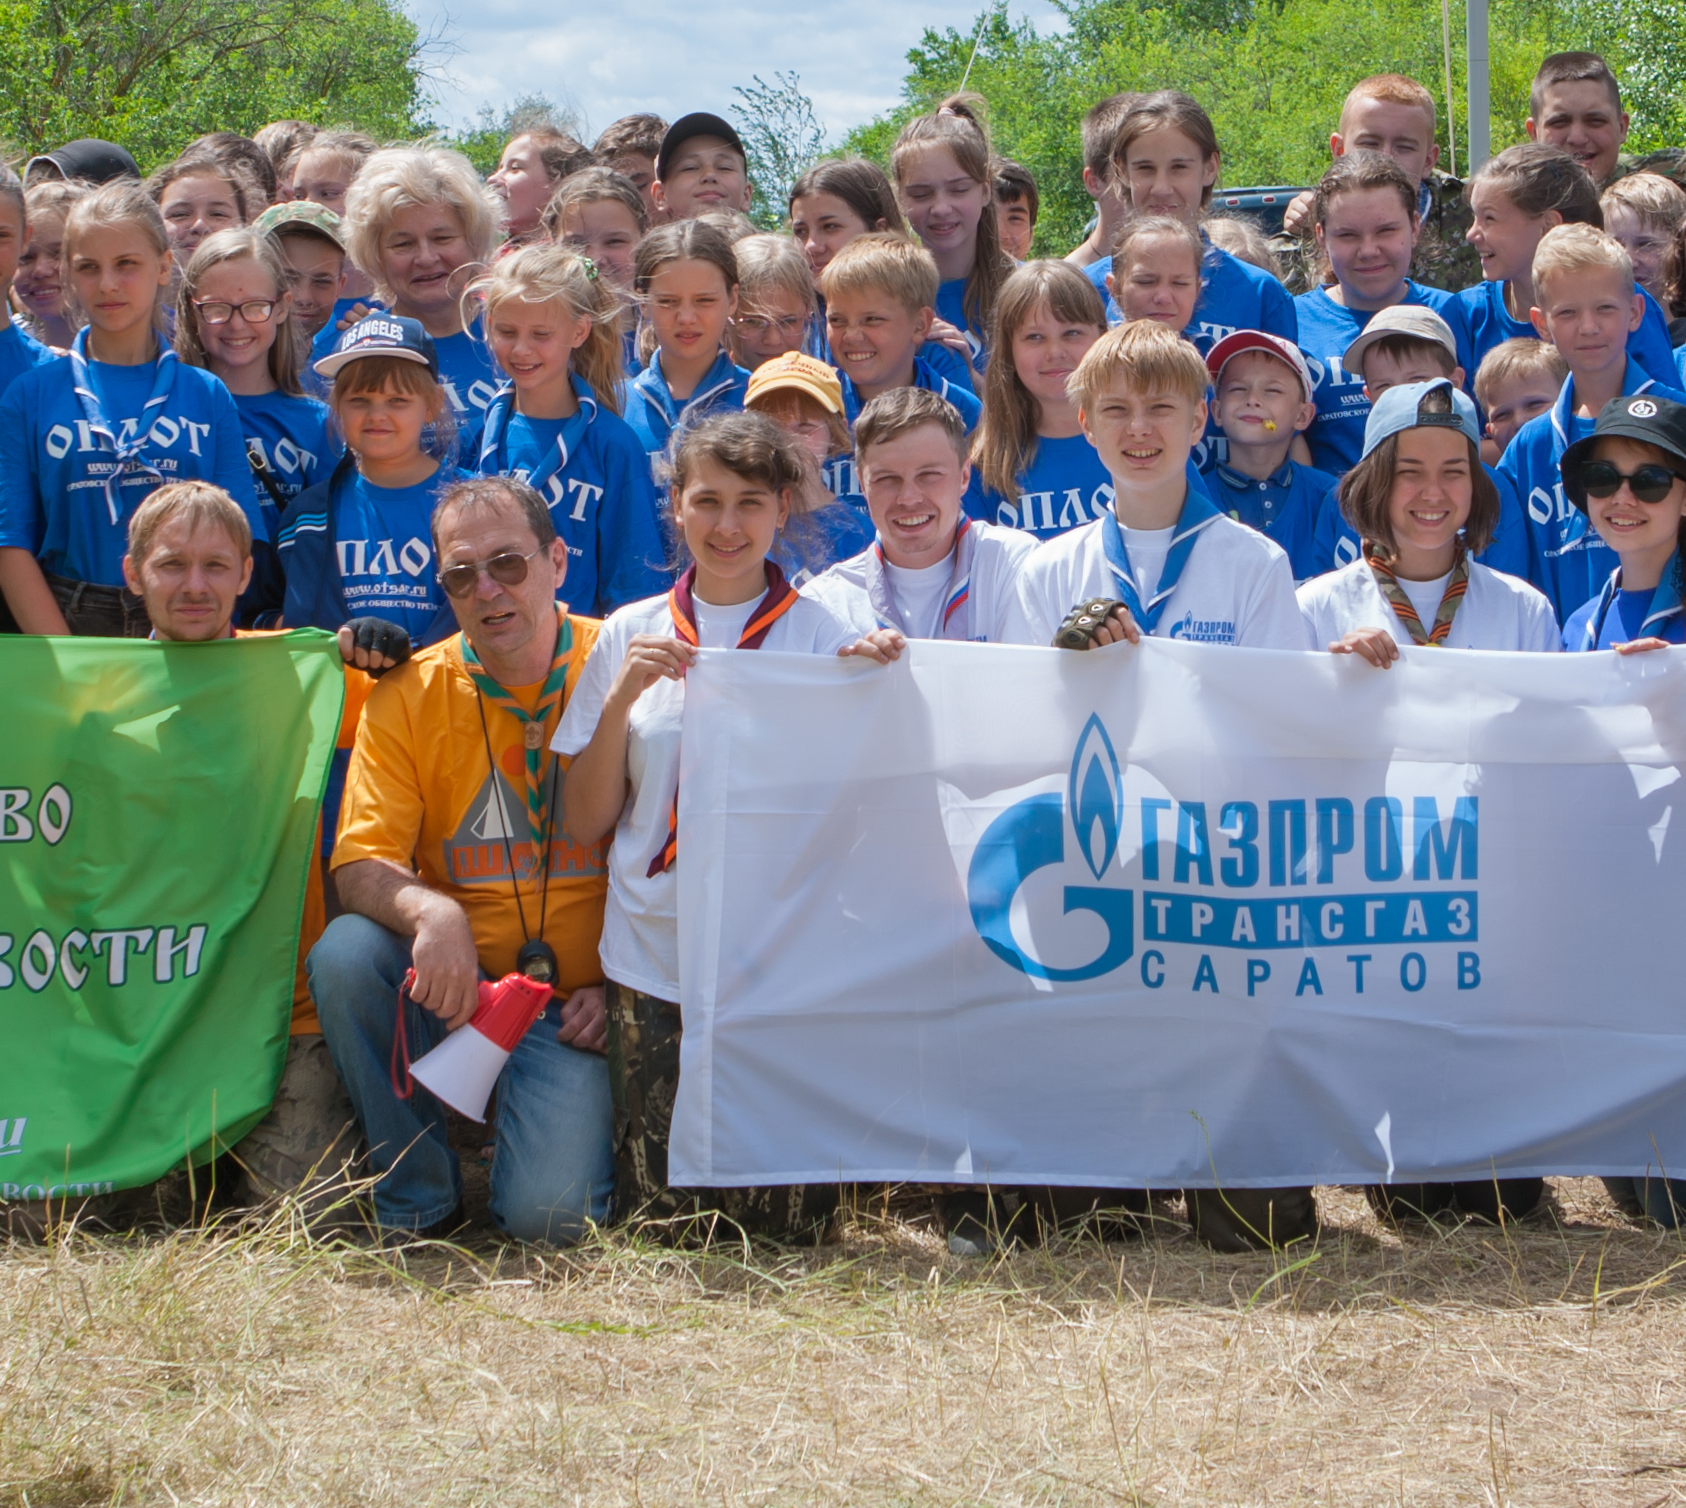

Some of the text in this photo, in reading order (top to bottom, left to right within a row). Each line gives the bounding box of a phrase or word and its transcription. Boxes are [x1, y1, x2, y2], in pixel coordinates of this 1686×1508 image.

[341, 328, 358, 352] LOS
[357, 320, 404, 342] ANGELES
[336, 537, 436, 577] ПЛО
[343, 582, 427, 596] www.otsar.ru
[1193, 621, 1235, 634] ГАЗПРОМ
[1140, 796, 1479, 888] ГАЗПРОМ
[1151, 897, 1471, 942] ТРАНСГАЗ
[1140, 949, 1482, 997] САРАТОВ
